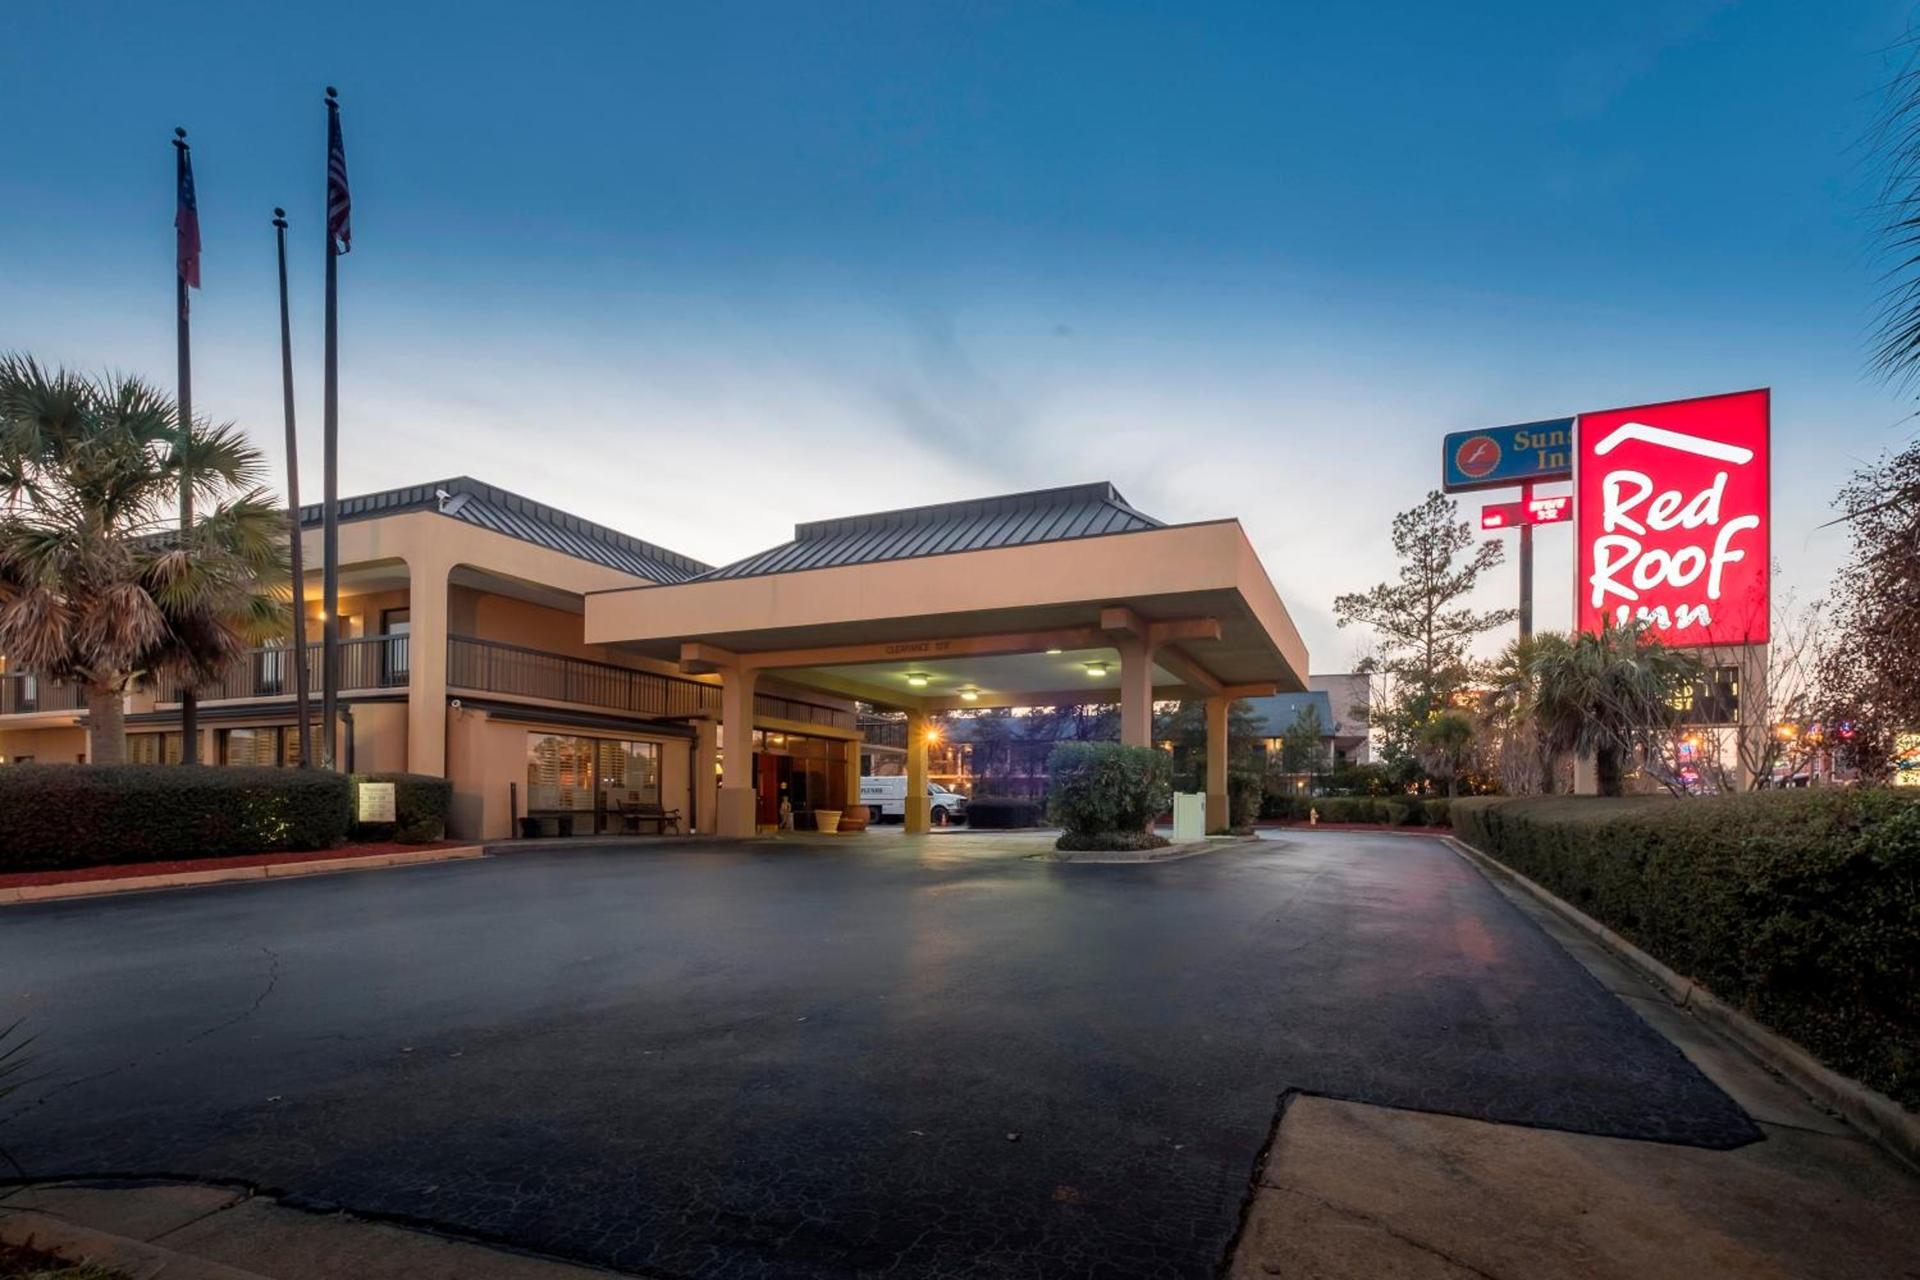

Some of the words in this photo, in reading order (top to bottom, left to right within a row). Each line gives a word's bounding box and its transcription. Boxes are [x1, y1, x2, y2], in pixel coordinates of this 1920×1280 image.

[1513, 430, 1573, 451] Sun
[1537, 450, 1573, 470] In
[1602, 470, 1729, 536] Red
[1589, 514, 1760, 609] Roof
